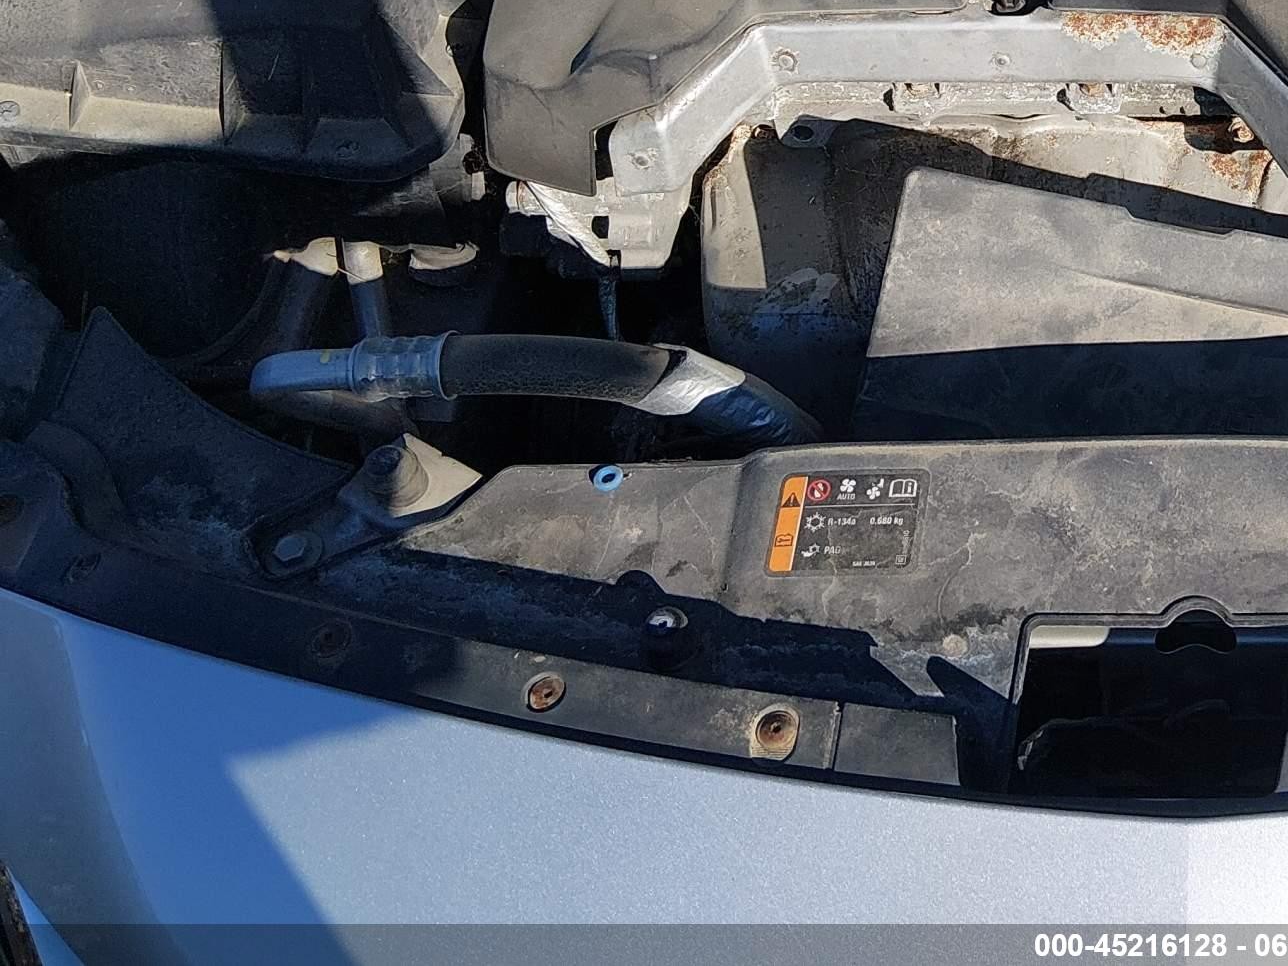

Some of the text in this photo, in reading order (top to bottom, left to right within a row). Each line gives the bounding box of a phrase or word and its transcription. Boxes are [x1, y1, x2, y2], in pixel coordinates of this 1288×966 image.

[837, 493, 856, 501] AUTO
[828, 516, 905, 527] R-134a 0.680 kg
